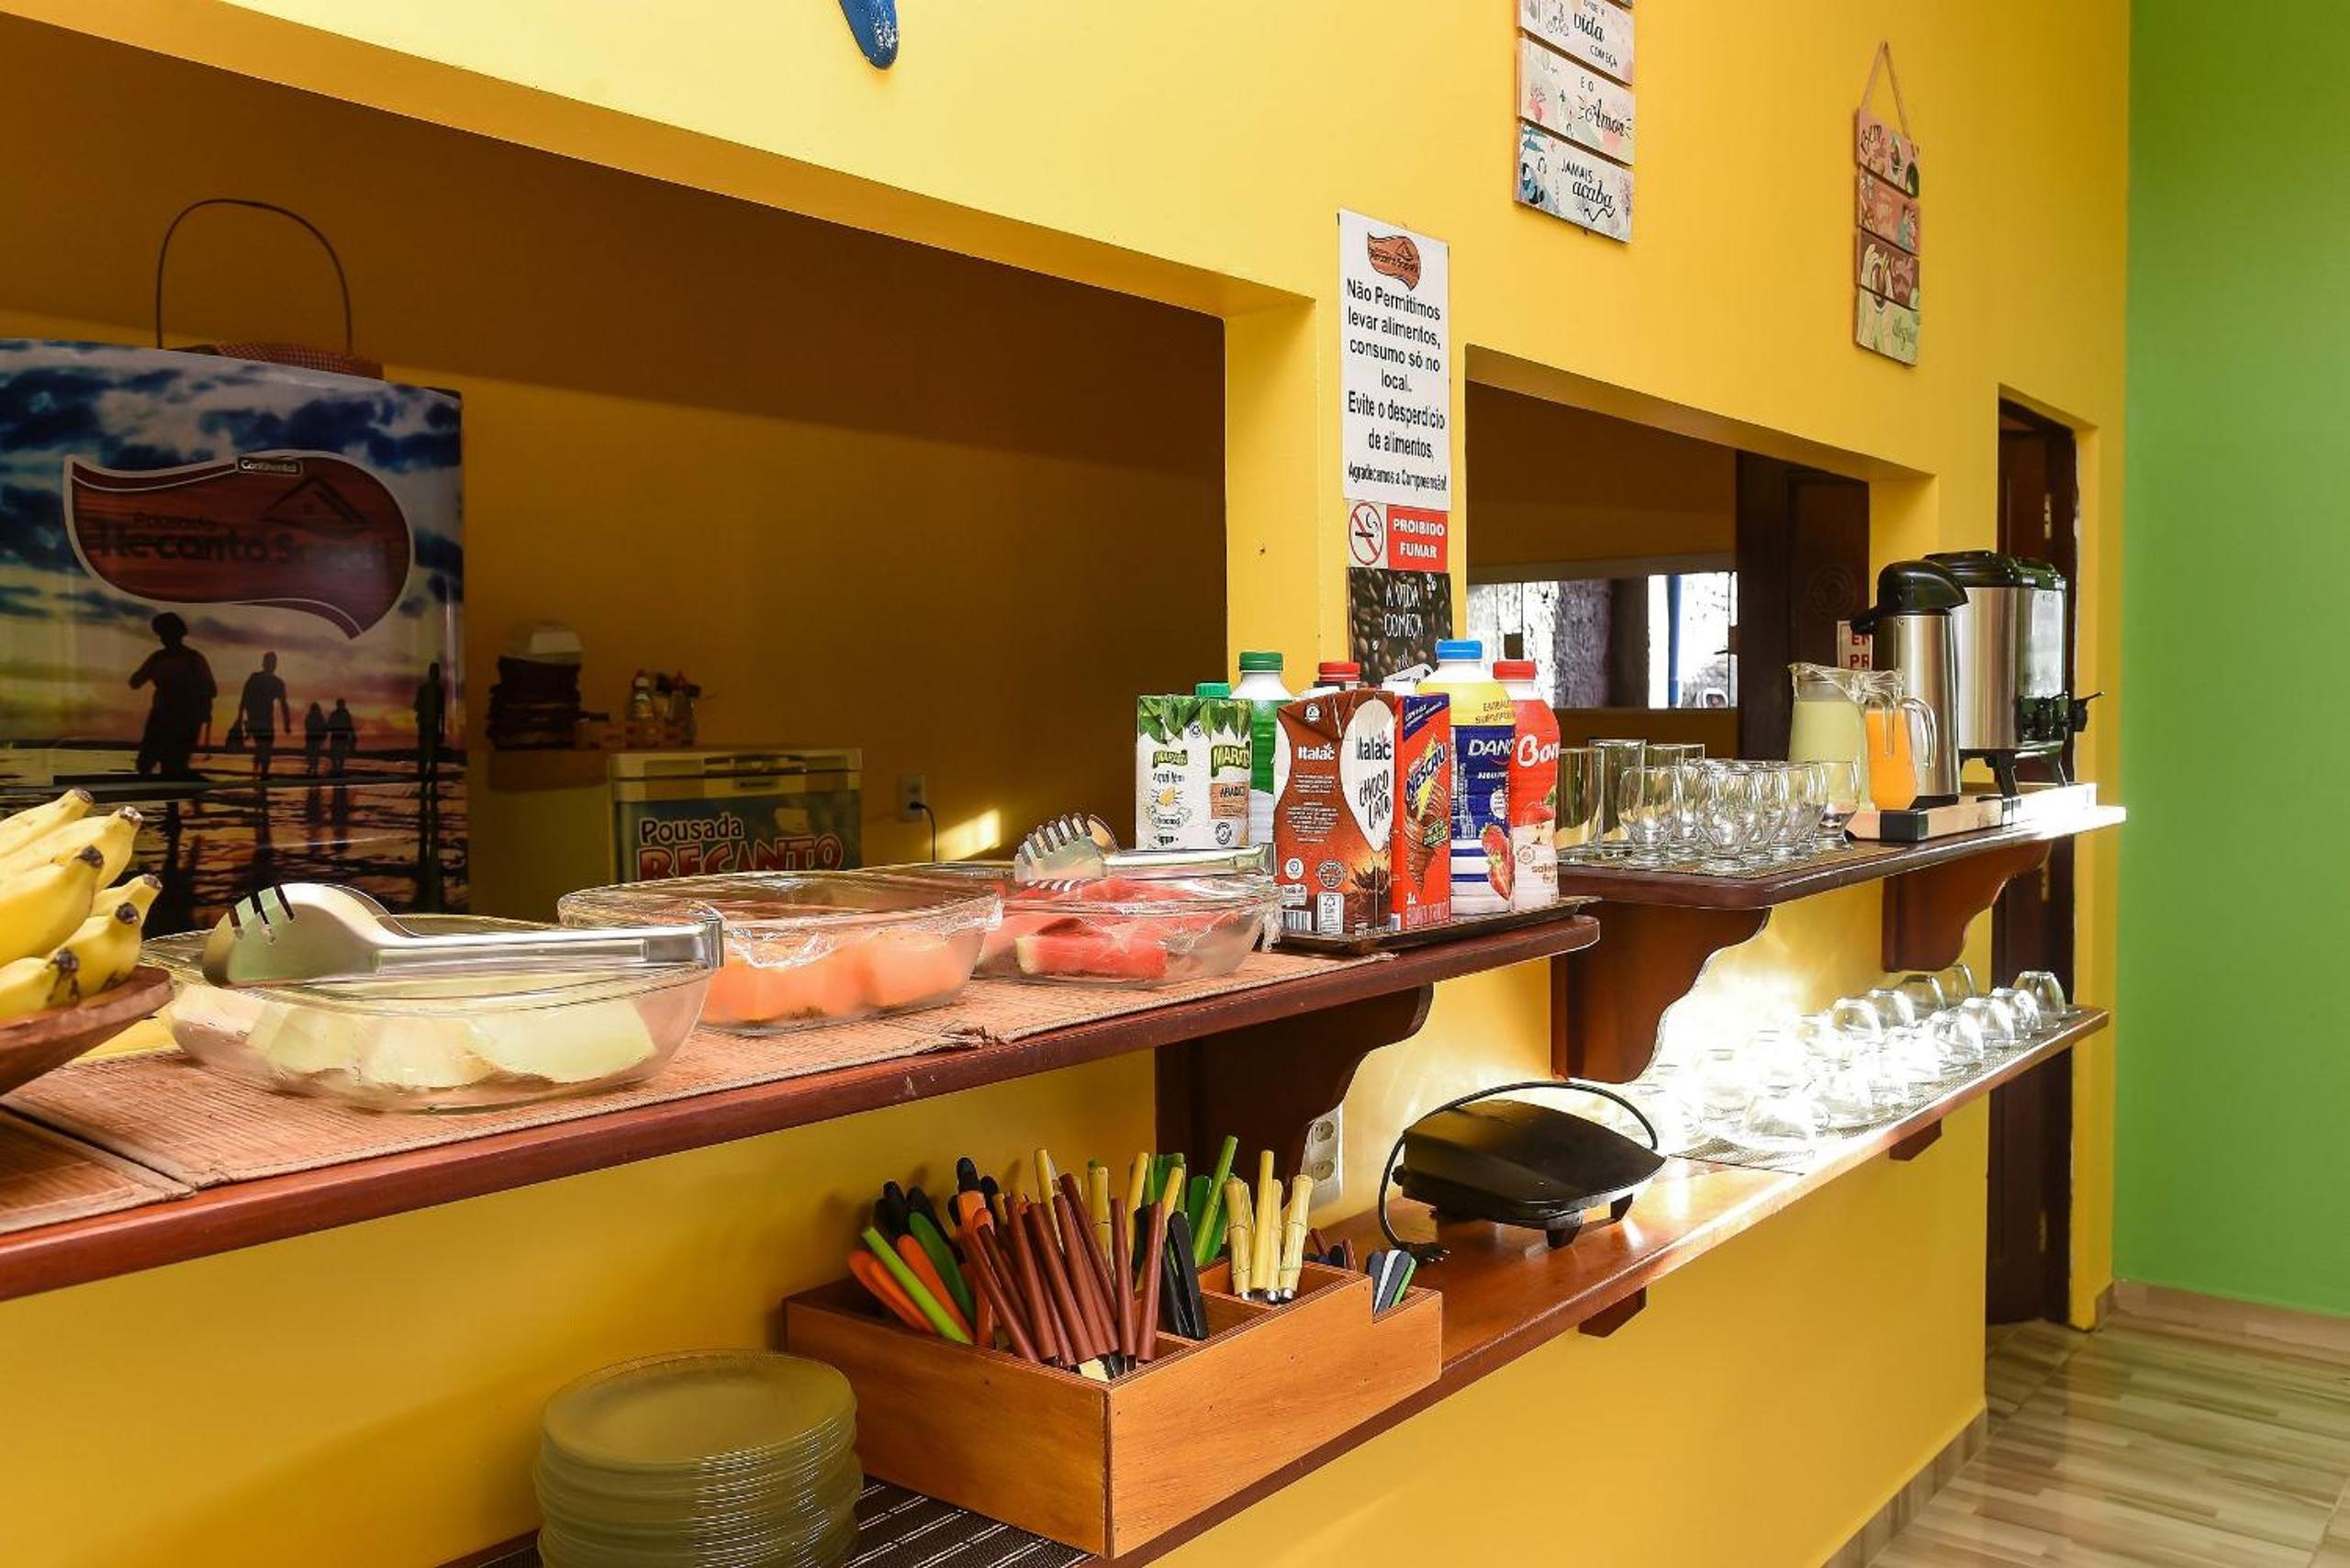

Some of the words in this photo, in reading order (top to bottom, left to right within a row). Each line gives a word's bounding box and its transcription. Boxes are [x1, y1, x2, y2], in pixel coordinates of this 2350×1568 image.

[1561, 158, 1593, 184] JAMAIS
[1347, 277, 1371, 301] Não
[1375, 286, 1440, 320] Permitimos
[1348, 306, 1378, 331] levar
[1382, 316, 1440, 350] alimentos,
[1349, 339, 1405, 364] consumo
[1408, 351, 1423, 368] só
[1426, 357, 1440, 372] no
[1381, 369, 1412, 392] local.
[1348, 390, 1374, 418] Evite
[1378, 402, 1385, 419] o
[1388, 399, 1445, 430] desperdício
[1369, 428, 1381, 450] de
[1393, 518, 1445, 537] PROIBIDO
[1399, 543, 1438, 559] FUMAR
[1386, 584, 1393, 607] A
[1395, 584, 1420, 608] VIDA
[1384, 613, 1424, 639] COMEÇA
[1298, 743, 1336, 760] Italac
[1356, 734, 1392, 760] Italac
[640, 812, 744, 844] Pousada
